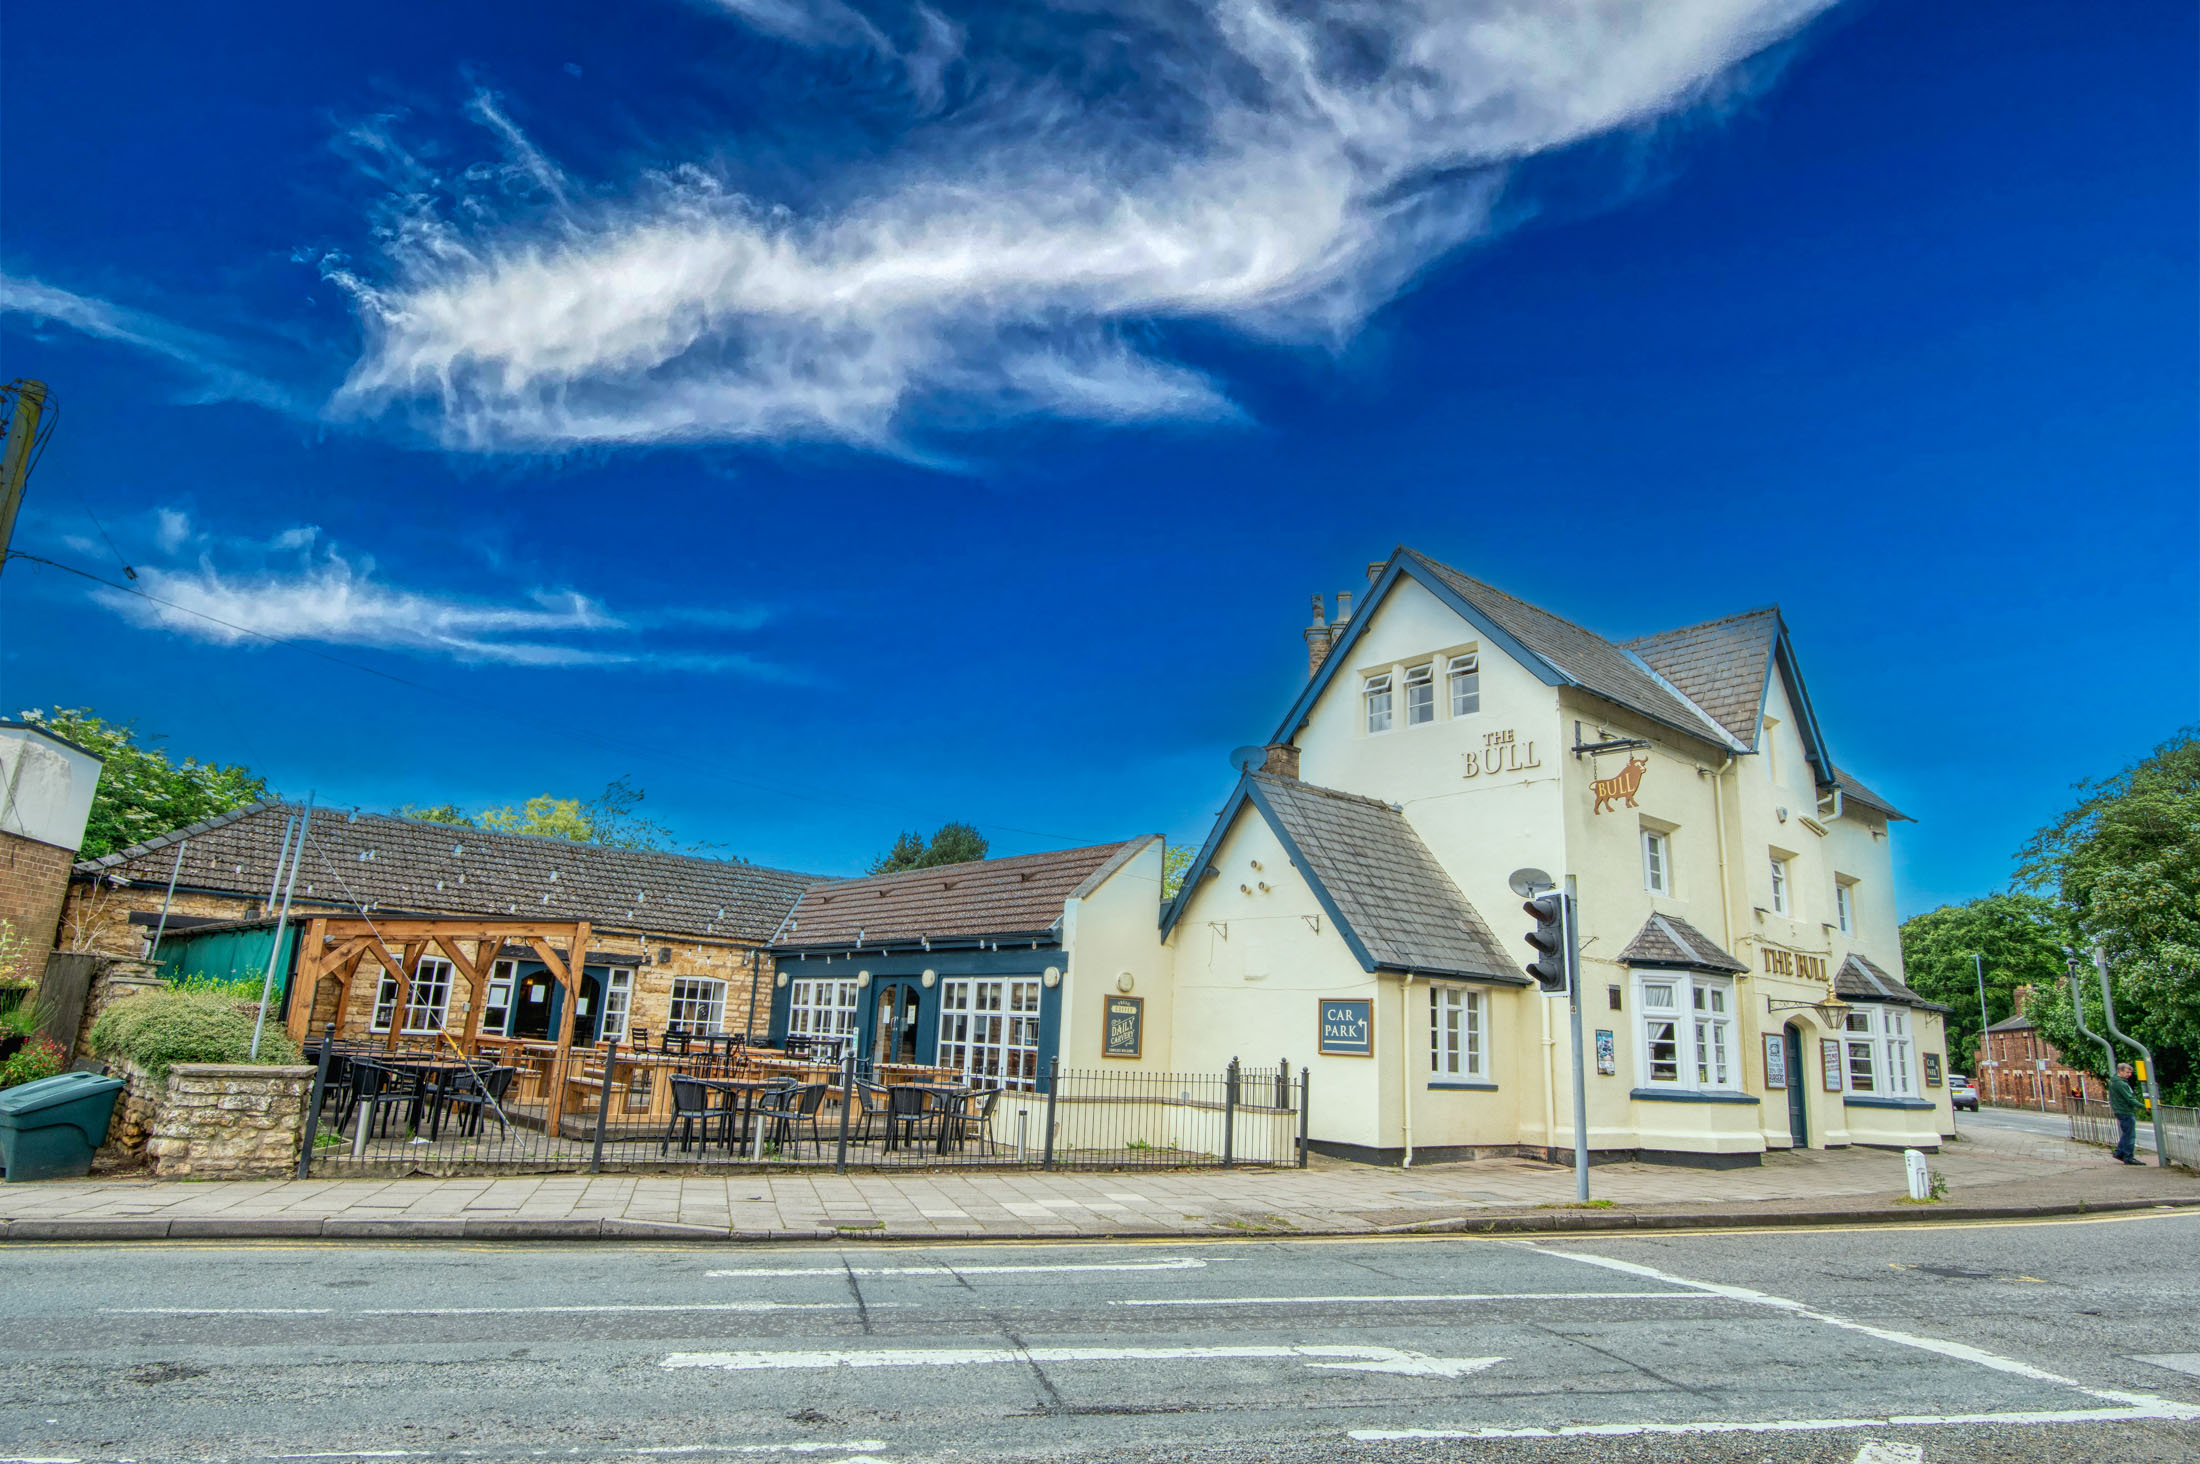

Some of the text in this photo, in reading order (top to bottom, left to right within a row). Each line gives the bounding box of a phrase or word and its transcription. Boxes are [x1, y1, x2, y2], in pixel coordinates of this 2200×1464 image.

[1482, 728, 1514, 746] THE
[1461, 741, 1541, 778] BULL
[1598, 773, 1635, 797] BULL
[1761, 947, 1829, 981] THE BULL
[1327, 1009, 1354, 1021] CAR
[1111, 1017, 1135, 1037] DAILY
[1324, 1024, 1357, 1037] PARK
[1110, 1029, 1135, 1045] CARVERY
